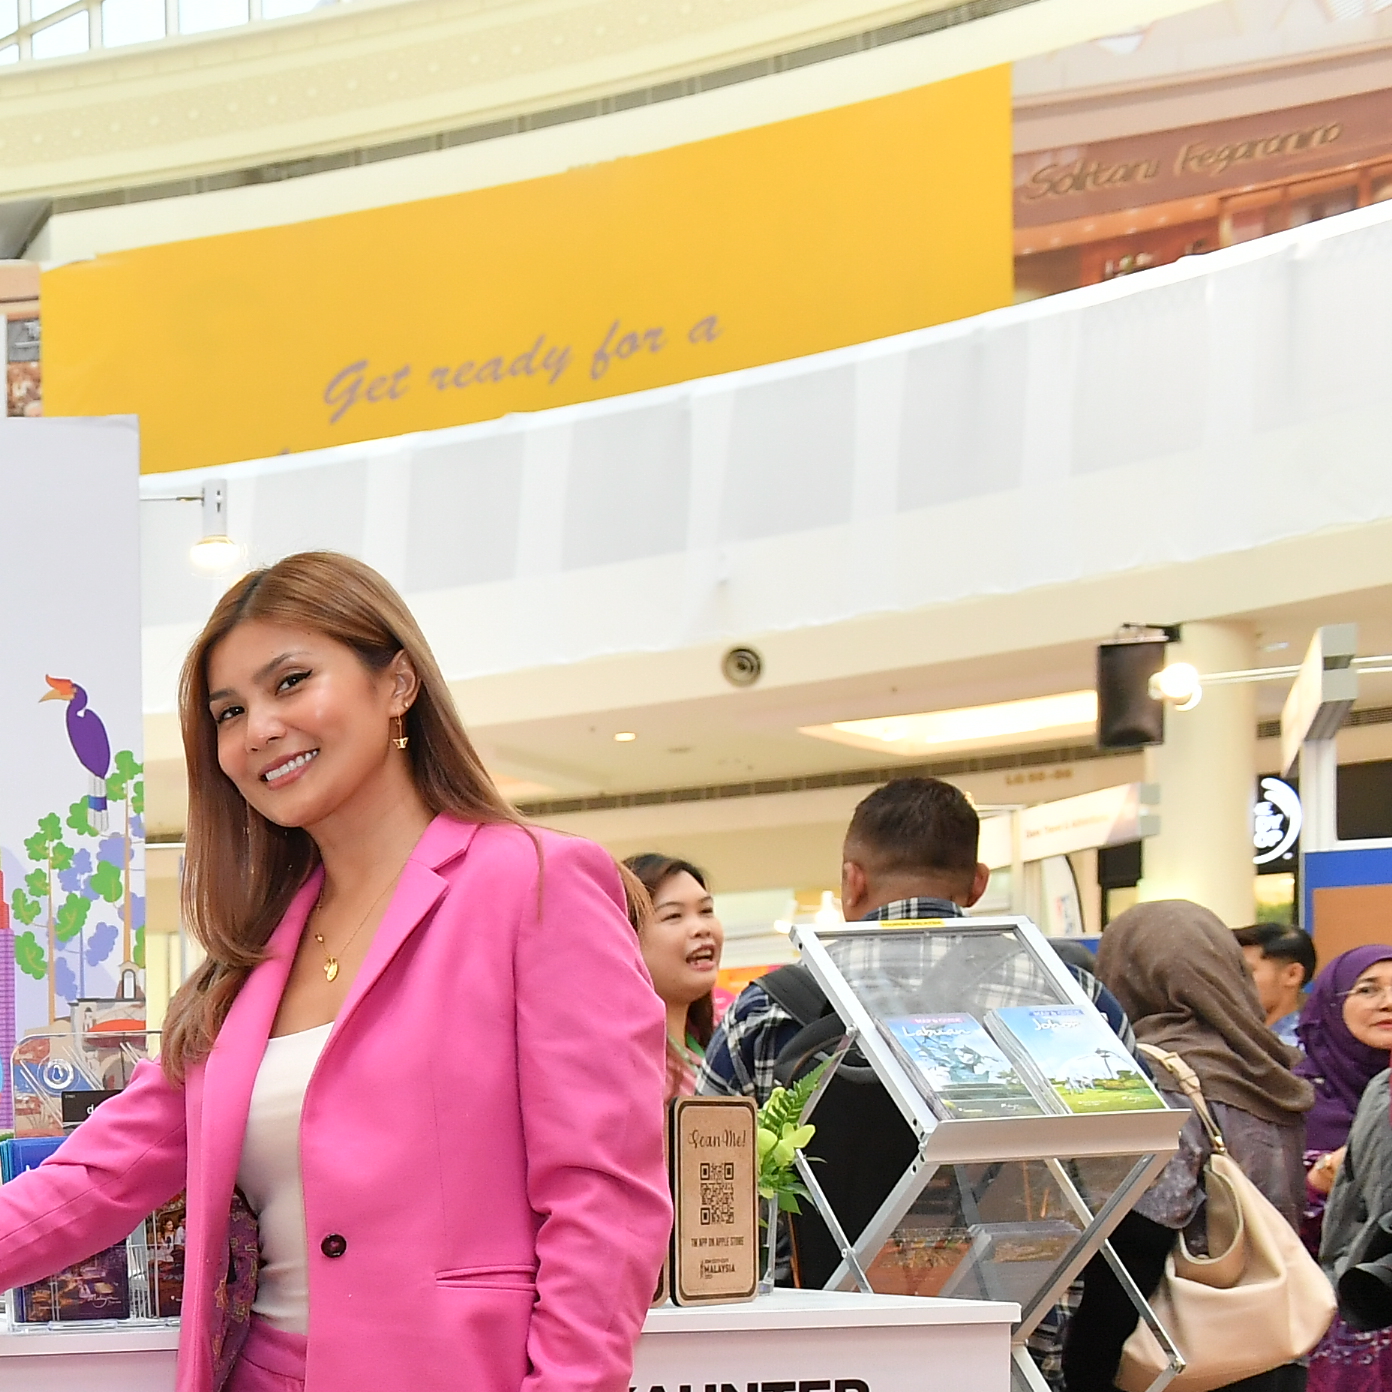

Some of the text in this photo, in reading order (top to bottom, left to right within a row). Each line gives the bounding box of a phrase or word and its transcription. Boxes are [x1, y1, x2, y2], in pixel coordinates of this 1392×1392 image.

[323, 313, 722, 426] Get ready for a
[902, 1025, 972, 1037] Labuan
[687, 1129, 721, 1149] Scan
[704, 1263, 736, 1273] MALAYSIA
